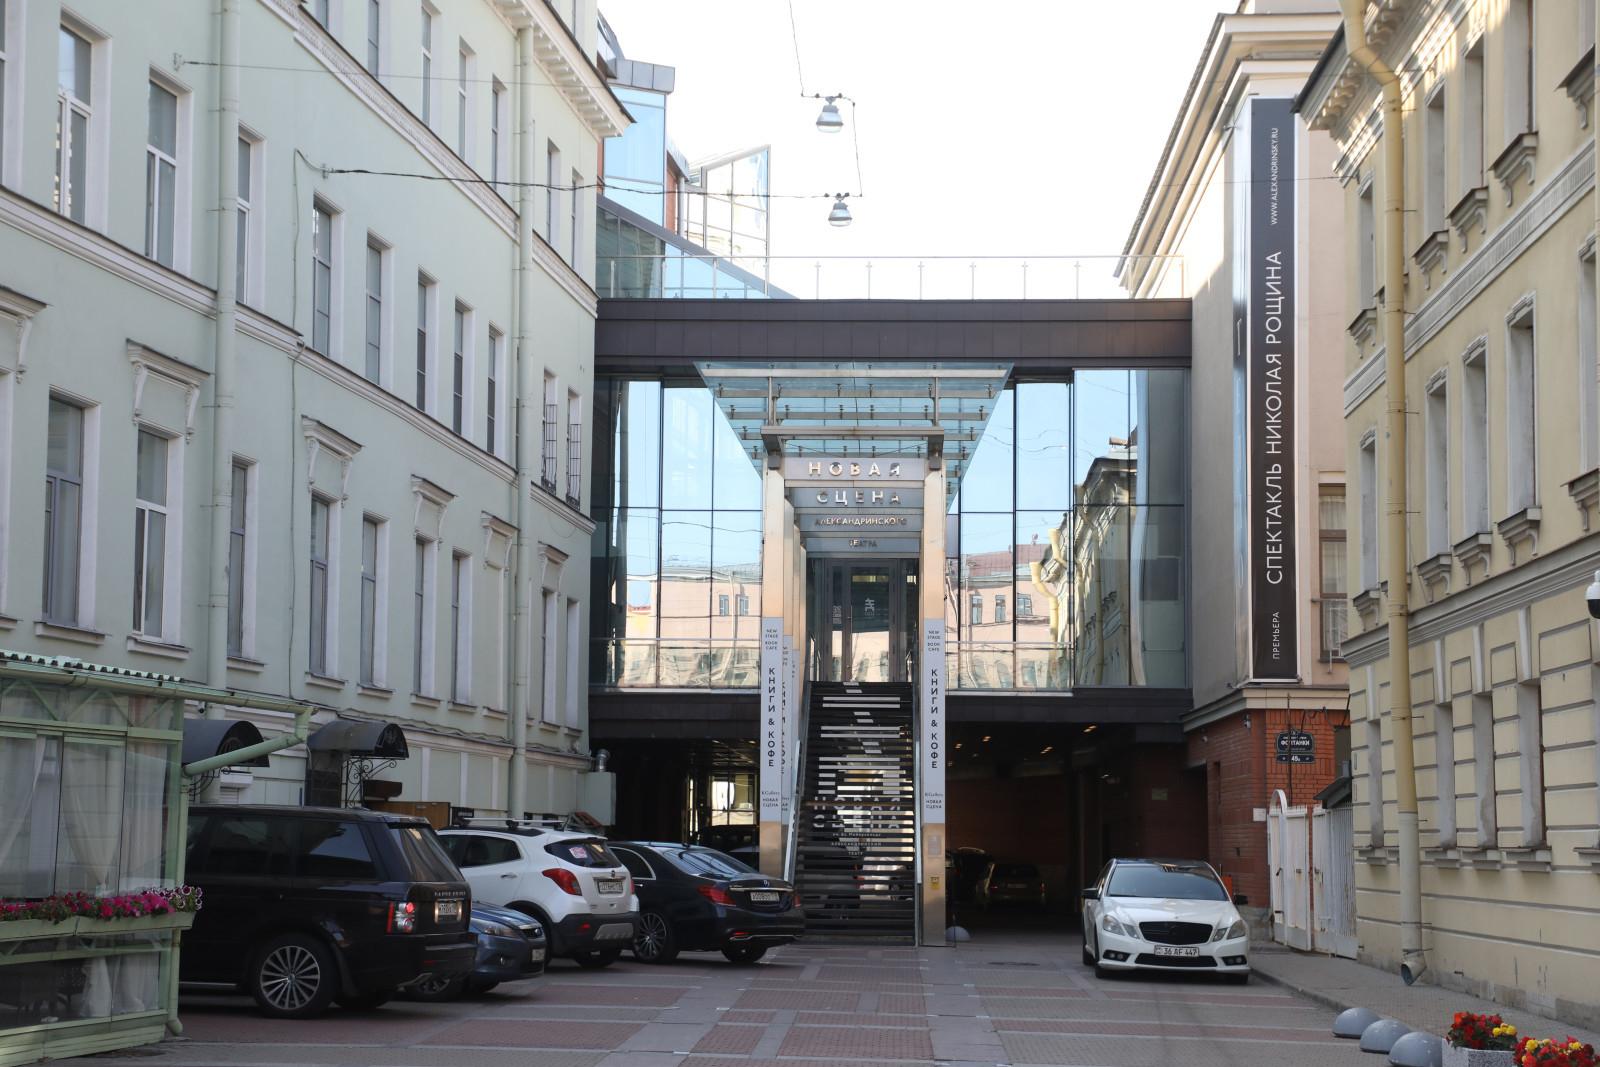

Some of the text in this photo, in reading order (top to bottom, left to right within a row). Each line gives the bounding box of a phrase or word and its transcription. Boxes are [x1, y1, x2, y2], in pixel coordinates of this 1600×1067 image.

[1270, 127, 1279, 225] WWW.ALEXANDRINSKY.RU
[1266, 251, 1285, 584] СПЕКТАКЛЬ НИКОЛАЯ РОЩИНА
[808, 461, 900, 477] НОВАЯ
[816, 490, 901, 506] СЦЕНА
[814, 516, 907, 527] АЛЕКСАНДРИНСКОГО
[767, 668, 776, 767] КНИГИ & КОФЕ
[931, 720, 938, 728] &
[930, 733, 939, 769] КОФЕ
